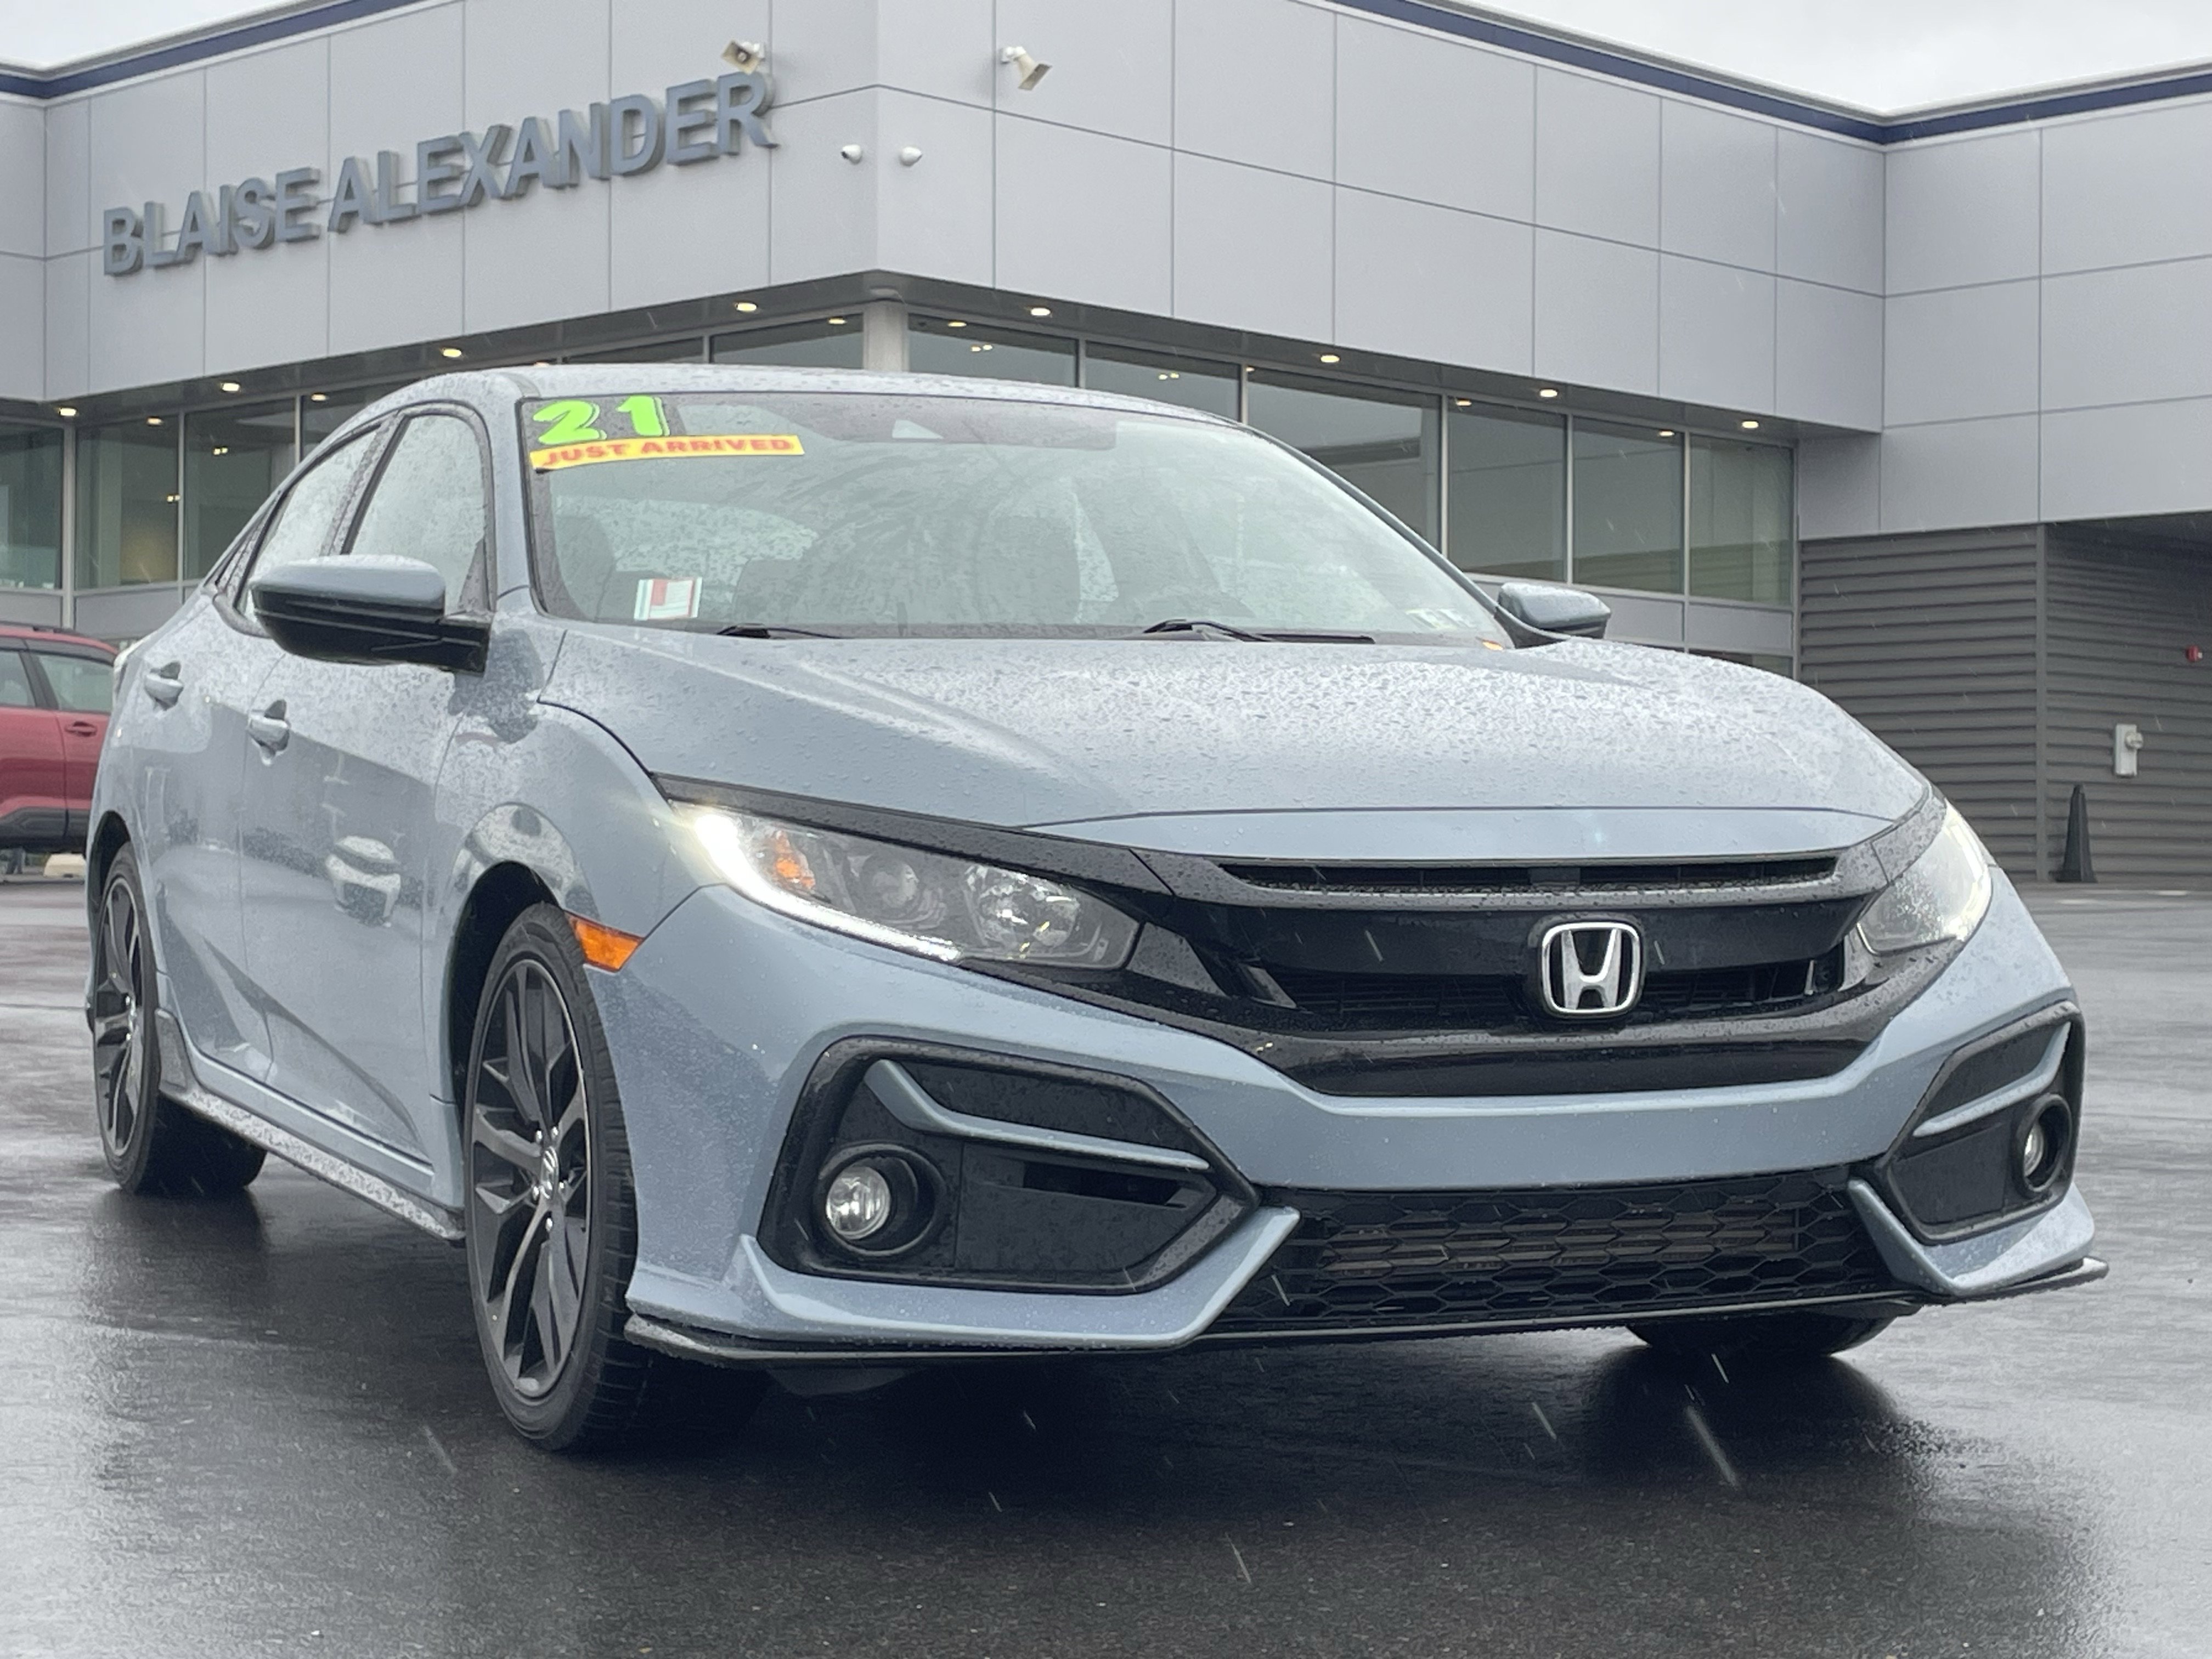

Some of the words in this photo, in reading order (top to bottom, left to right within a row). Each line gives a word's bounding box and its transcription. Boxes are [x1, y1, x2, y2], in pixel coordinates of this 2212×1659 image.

[103, 167, 321, 276] BLAISE
[328, 71, 780, 233] ALEXANDER
[533, 395, 670, 444] 21
[543, 443, 629, 466] JUST
[640, 439, 793, 453] ARRIVED
